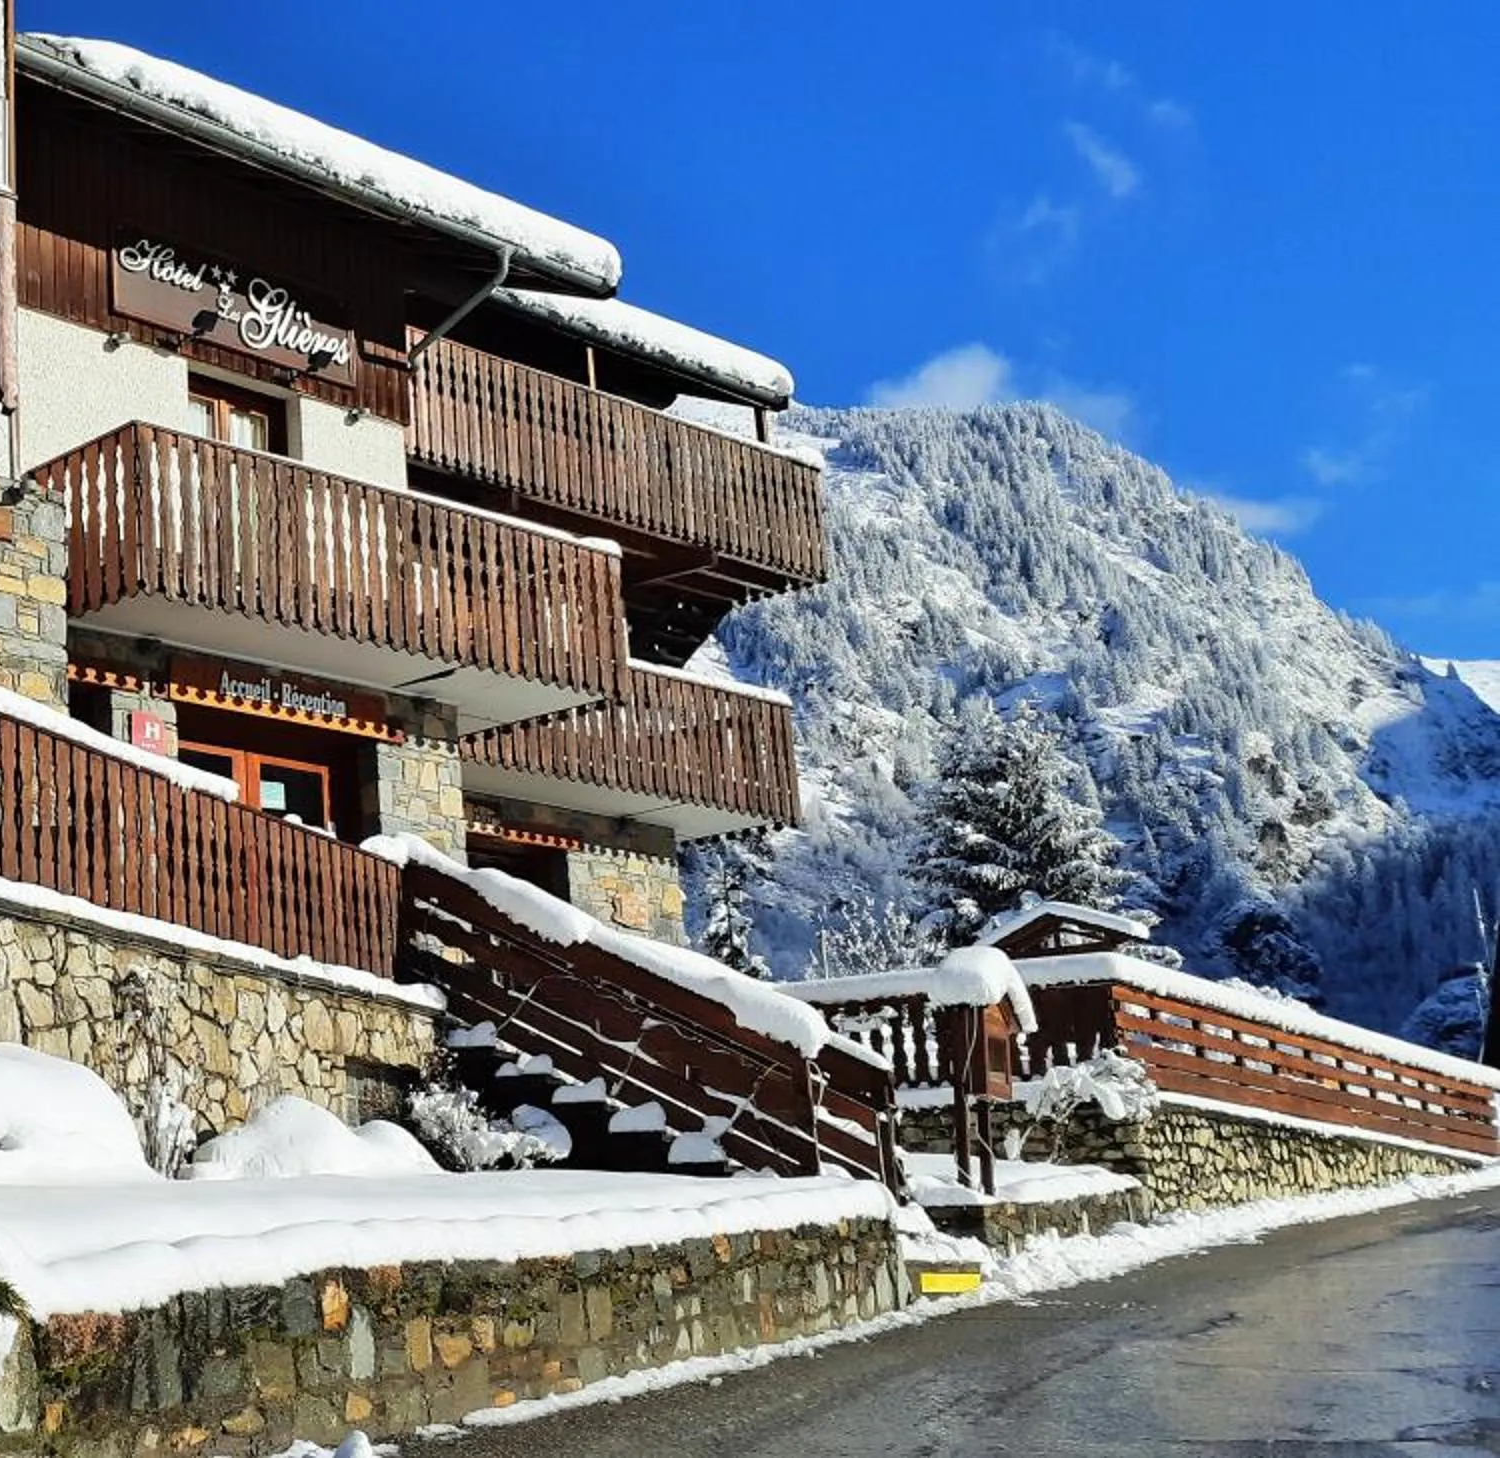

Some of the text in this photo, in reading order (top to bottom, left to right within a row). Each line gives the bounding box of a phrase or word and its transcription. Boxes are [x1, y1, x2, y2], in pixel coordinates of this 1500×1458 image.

[218, 293, 241, 322] Les
[239, 278, 350, 365] Glières
[218, 669, 272, 704] Accueil
[281, 682, 347, 718] Réception
[144, 720, 161, 741] H
